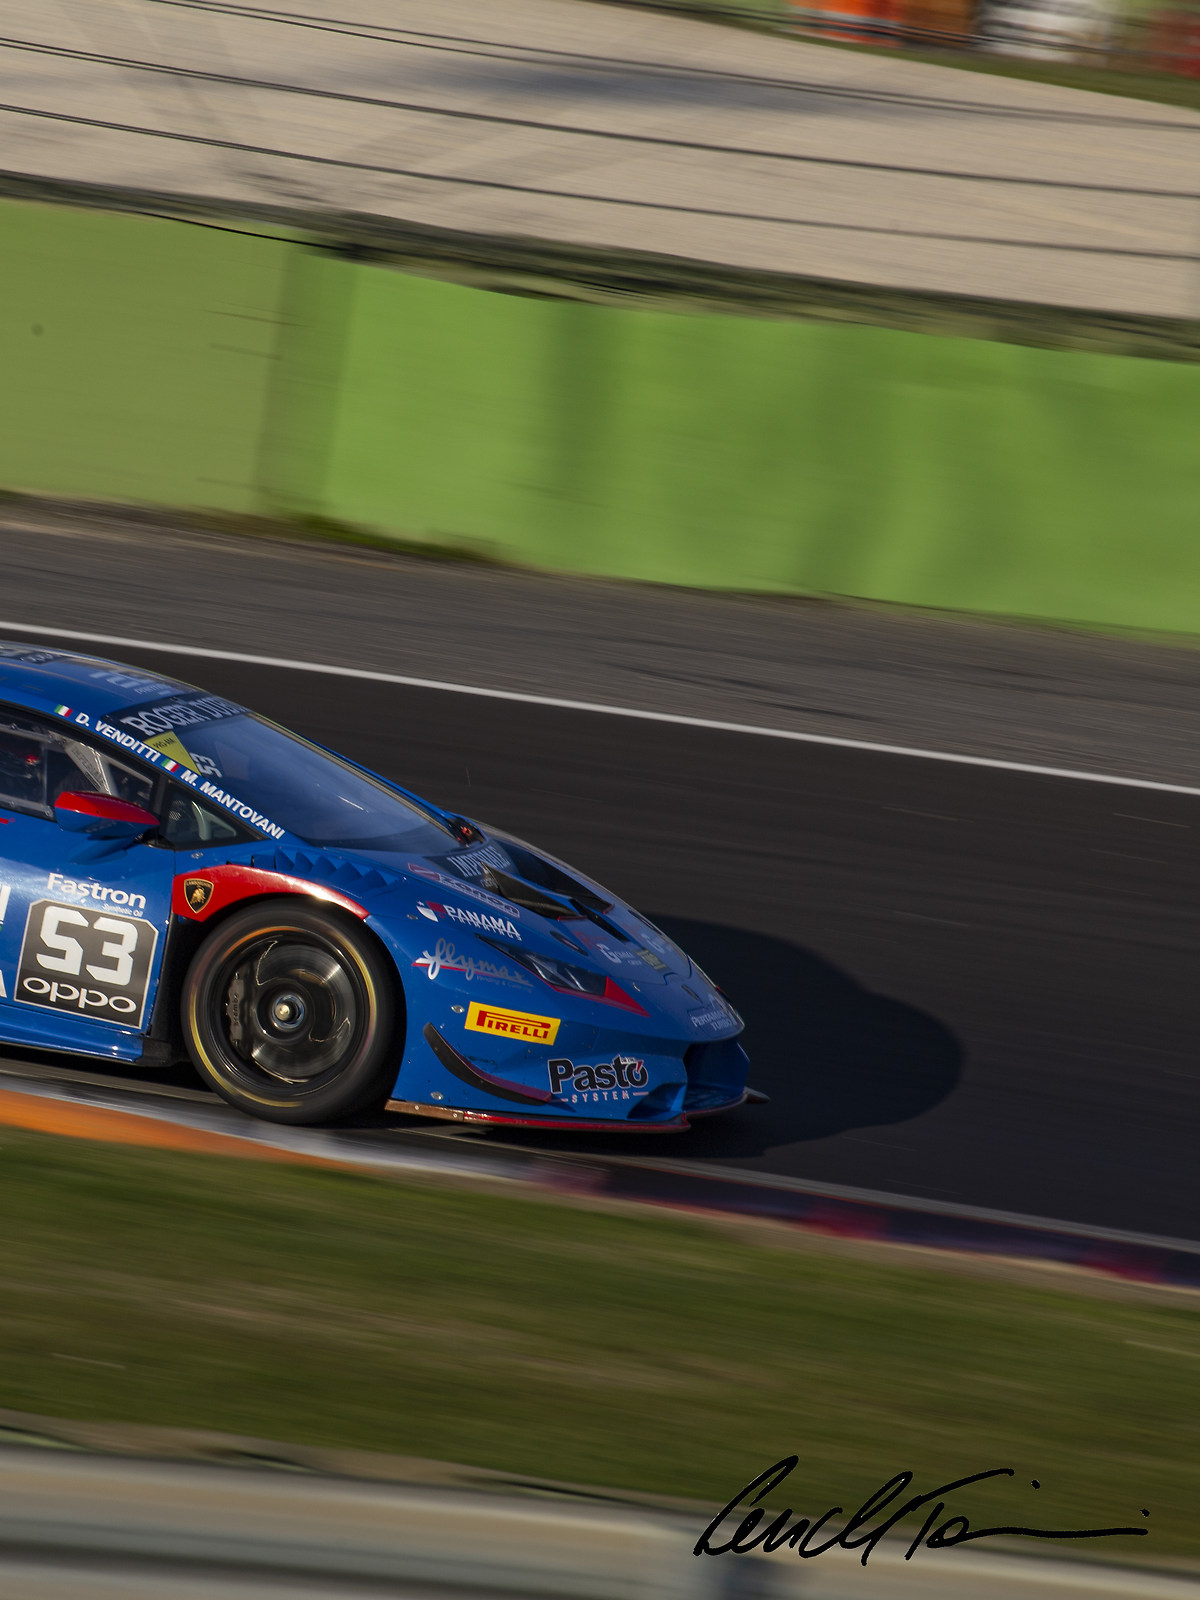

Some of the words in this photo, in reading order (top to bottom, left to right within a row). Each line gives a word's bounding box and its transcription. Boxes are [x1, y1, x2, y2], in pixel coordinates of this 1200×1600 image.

[75, 712, 90, 727] D.
[95, 720, 161, 763] VENDITTI
[180, 769, 197, 787] M.
[200, 780, 286, 840] MANTOVANI
[47, 872, 147, 910] Fastron
[103, 903, 132, 916] Synthetic
[133, 909, 143, 917] Oil
[443, 904, 520, 937] PANAMA
[36, 905, 139, 986] 53
[23, 977, 137, 1013] oppo
[476, 1010, 551, 1039] PIRELLI
[571, 1090, 629, 1104] SYSTEM
